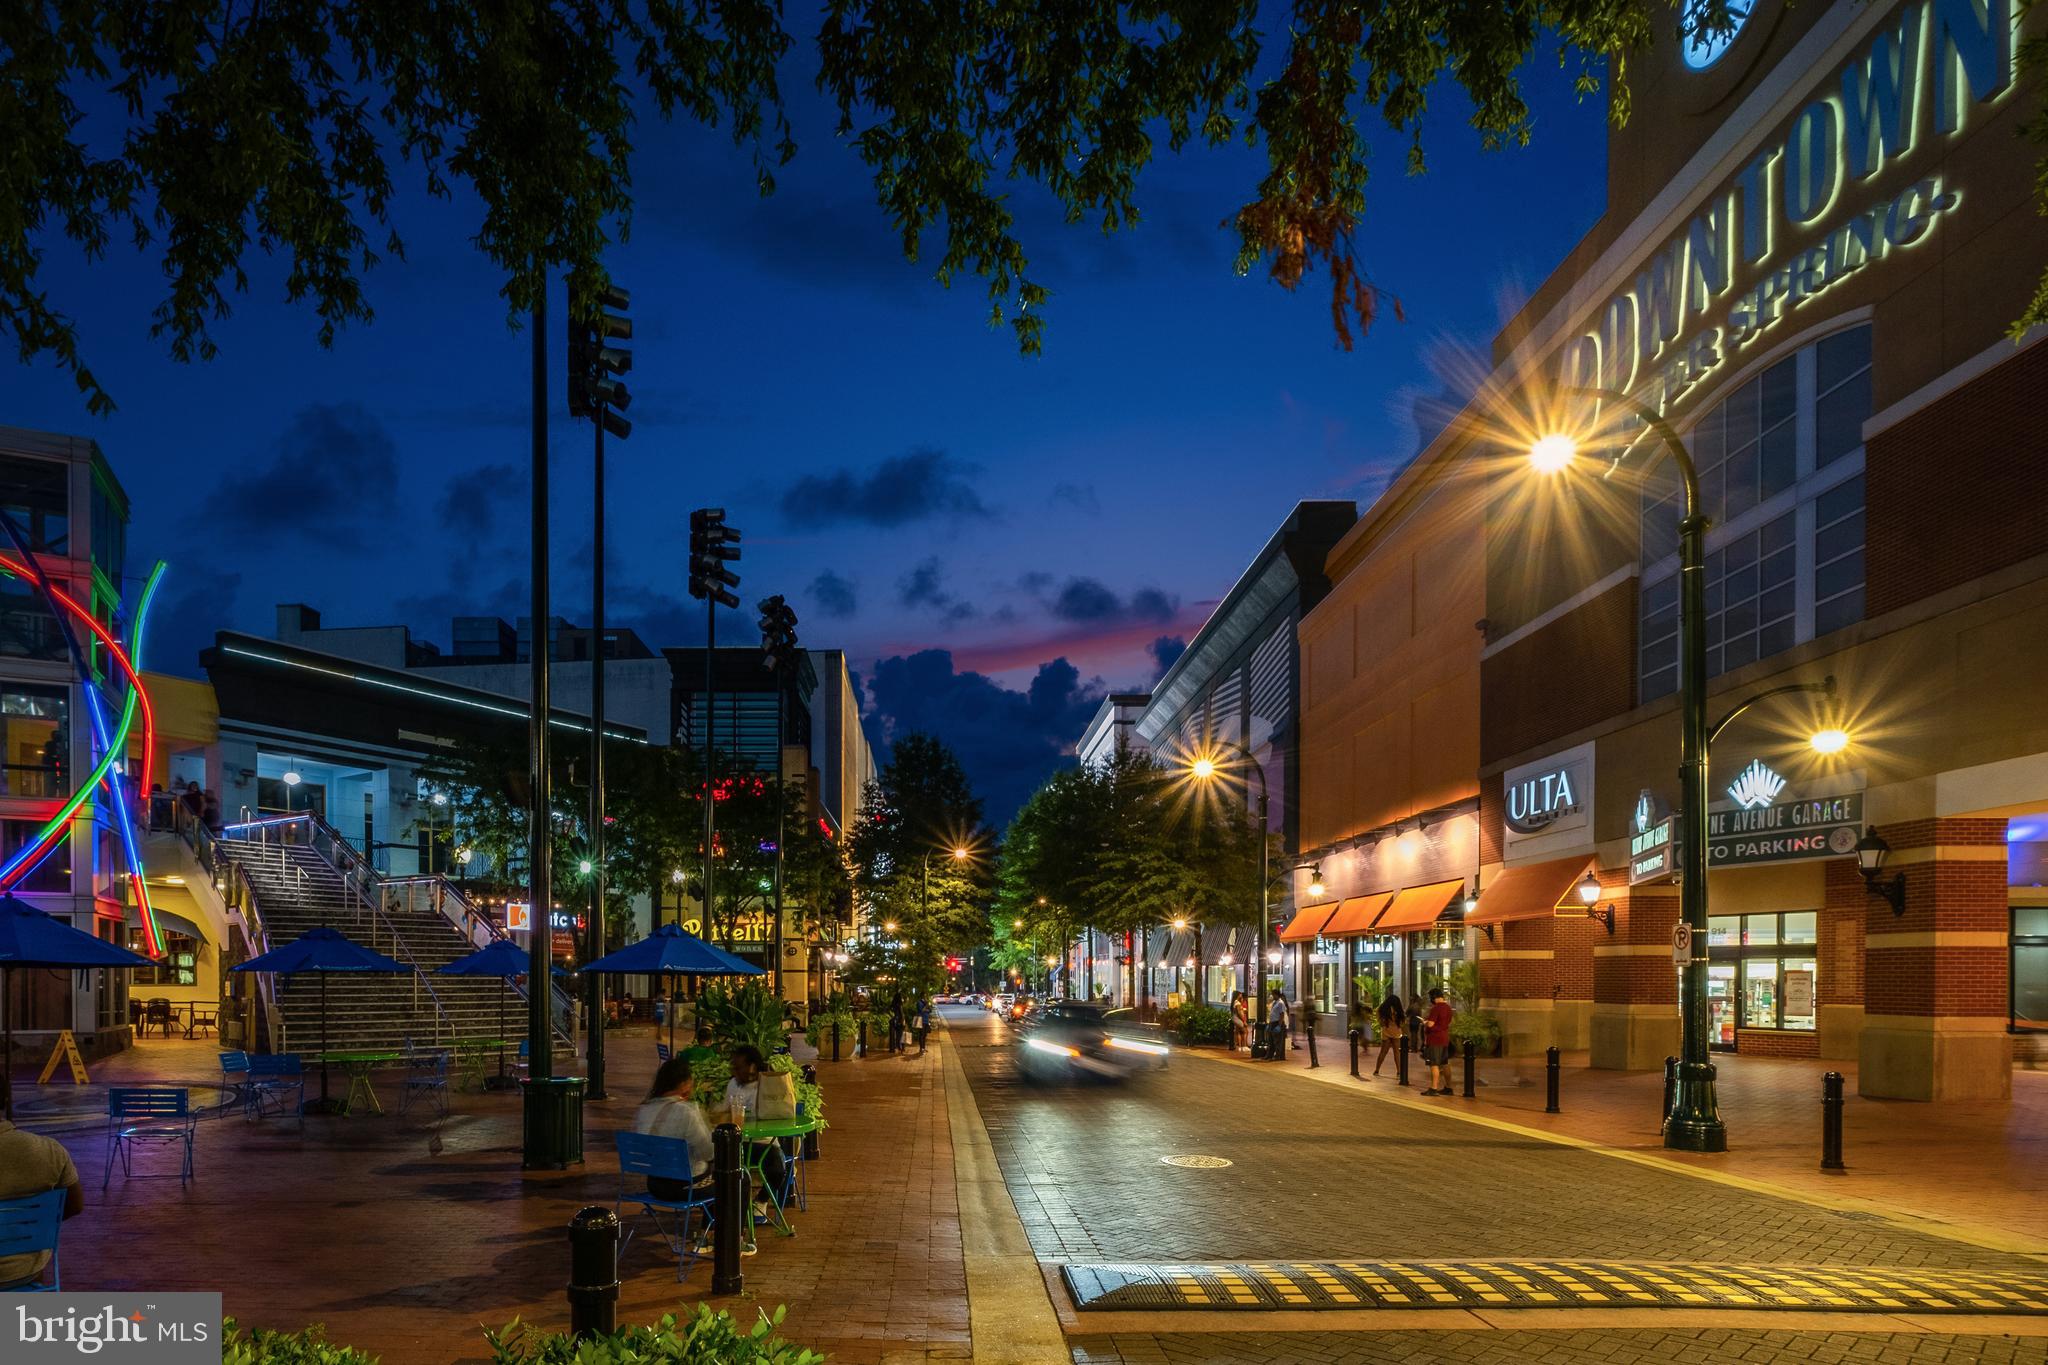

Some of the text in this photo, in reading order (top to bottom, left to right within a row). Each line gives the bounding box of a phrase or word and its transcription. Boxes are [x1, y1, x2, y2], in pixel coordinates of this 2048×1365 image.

[1728, 176, 1962, 351] SPRING
[1511, 770, 1573, 820] ULTA
[1733, 807, 1784, 832] AVENUE
[1792, 799, 1850, 825] GARAGE
[1707, 835, 1825, 860] TO PARKING
